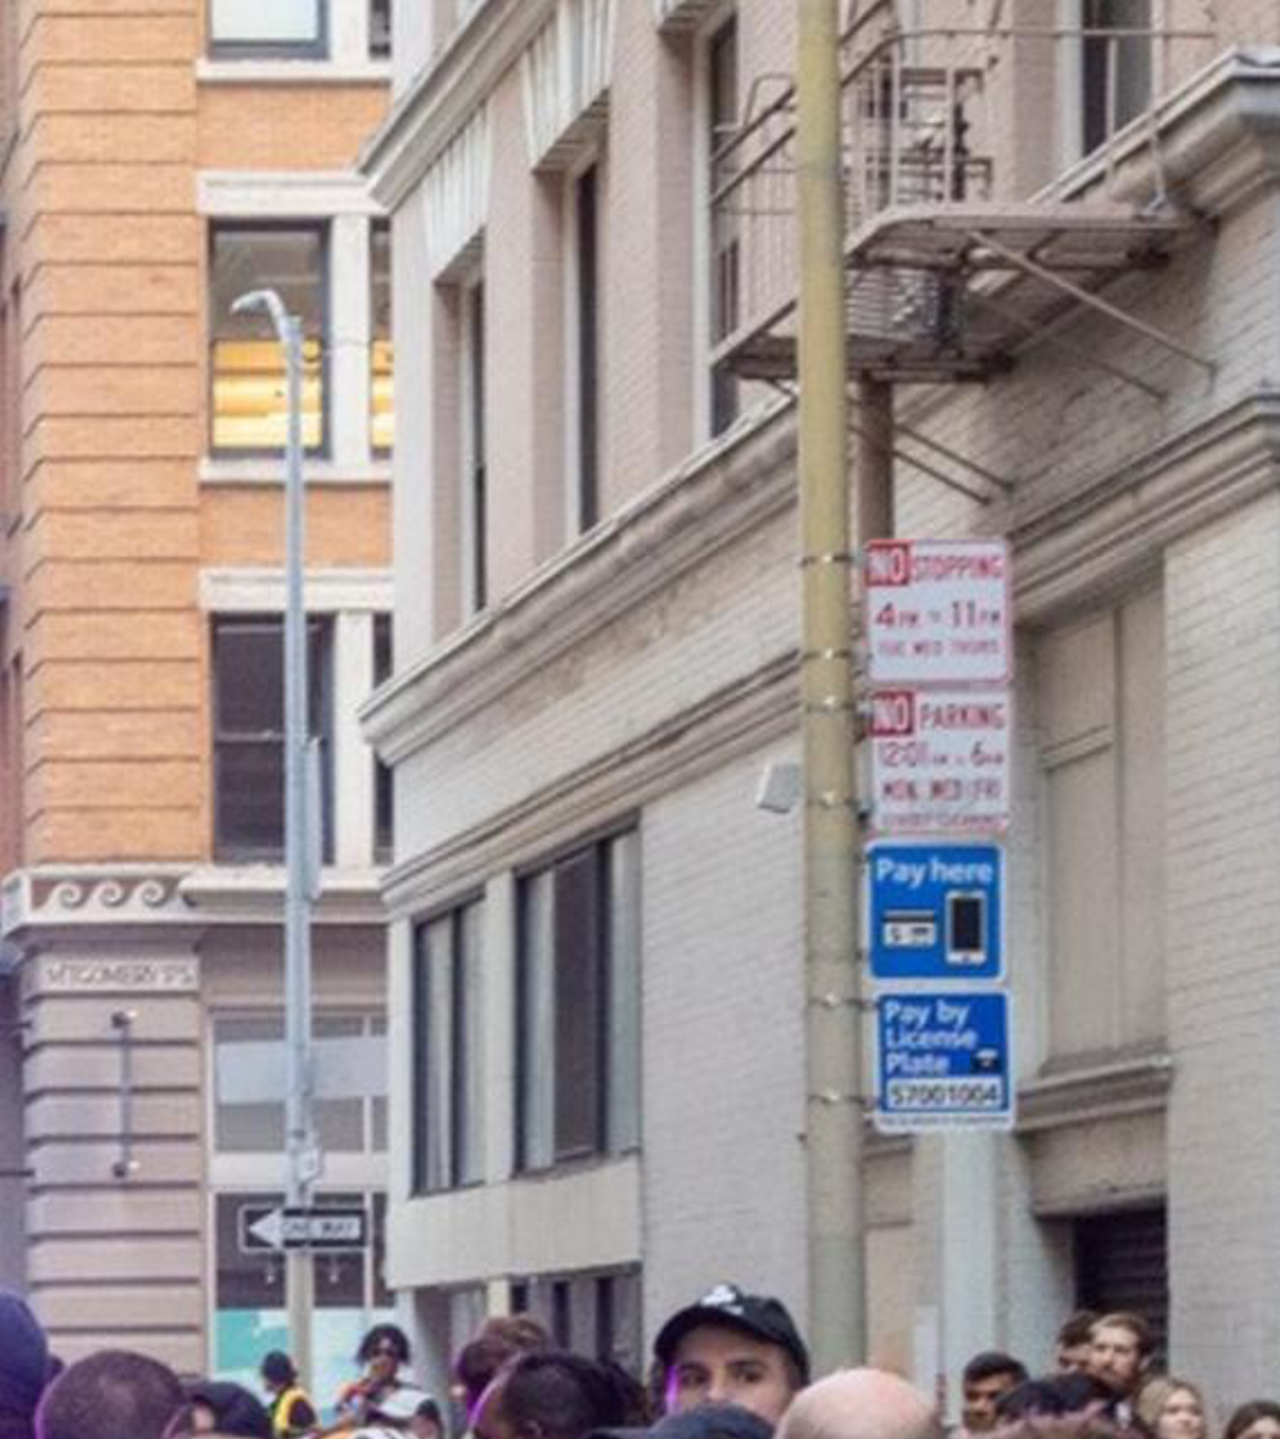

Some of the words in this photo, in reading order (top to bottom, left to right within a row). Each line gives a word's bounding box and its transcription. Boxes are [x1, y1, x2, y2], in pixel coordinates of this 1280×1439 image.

[870, 547, 905, 583] NO
[915, 555, 1005, 581] STOPPING
[873, 696, 909, 731] NO
[920, 703, 1005, 729] PARKING
[876, 857, 927, 889] Pay
[928, 856, 994, 883] here
[884, 1000, 930, 1029] Pay
[936, 998, 970, 1030] by
[885, 1028, 979, 1050] License
[886, 1052, 951, 1075] Plate
